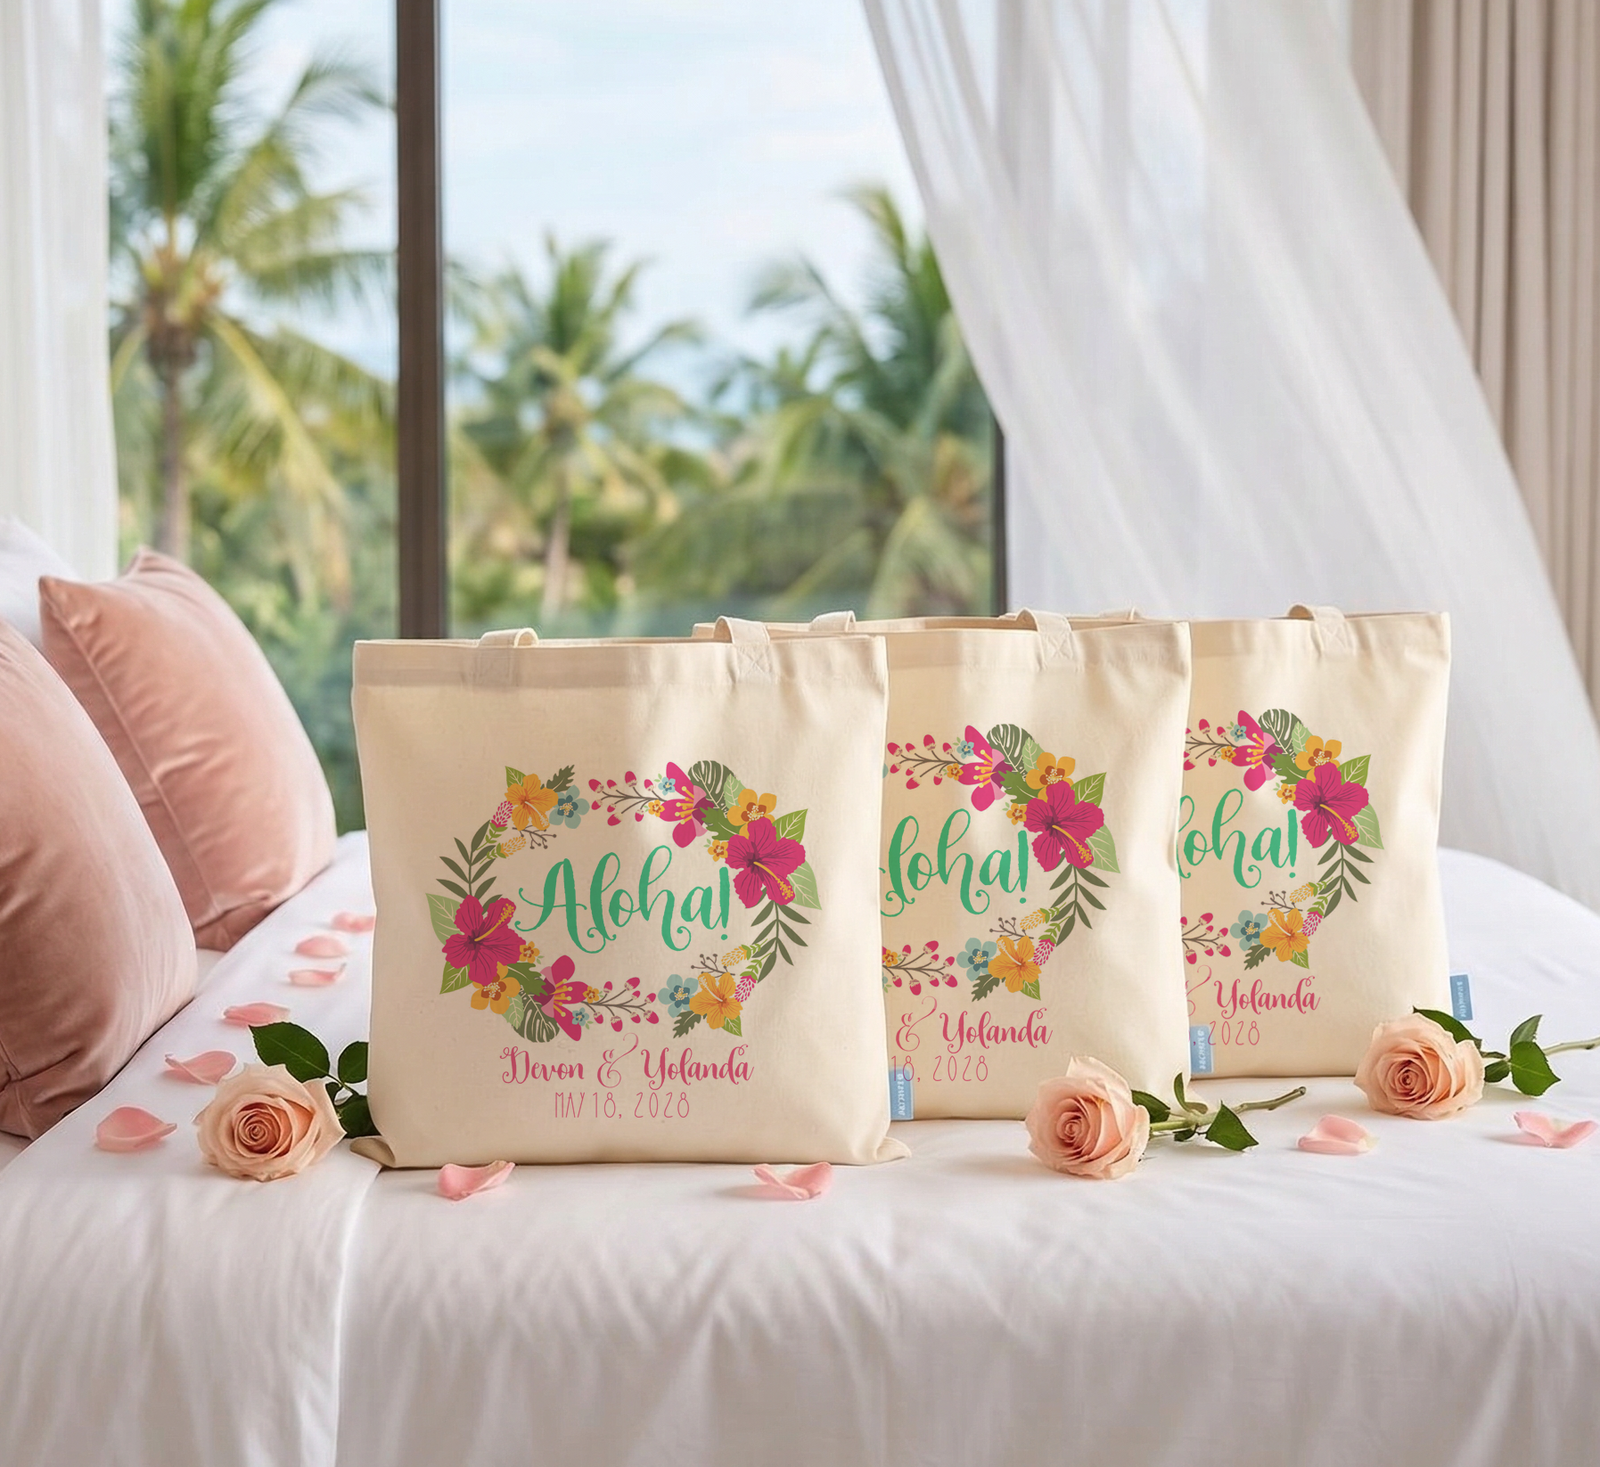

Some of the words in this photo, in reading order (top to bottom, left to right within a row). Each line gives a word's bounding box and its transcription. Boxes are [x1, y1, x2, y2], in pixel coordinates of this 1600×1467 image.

[879, 808, 1029, 917] loha!
[514, 845, 730, 954] Aloha!
[1213, 975, 1321, 1020] Yolanda
[895, 996, 937, 1052] &
[939, 1007, 1054, 1054] Yolanda
[1207, 1020, 1260, 1046] 2028
[500, 1046, 585, 1085] Devon
[597, 1032, 639, 1089] &
[640, 1044, 755, 1091] Yolanda
[891, 1055, 922, 1083] 18,
[932, 1055, 989, 1082] 2028
[554, 1092, 586, 1119] MAY
[592, 1092, 623, 1119] 18,
[633, 1092, 690, 1119] 2028
